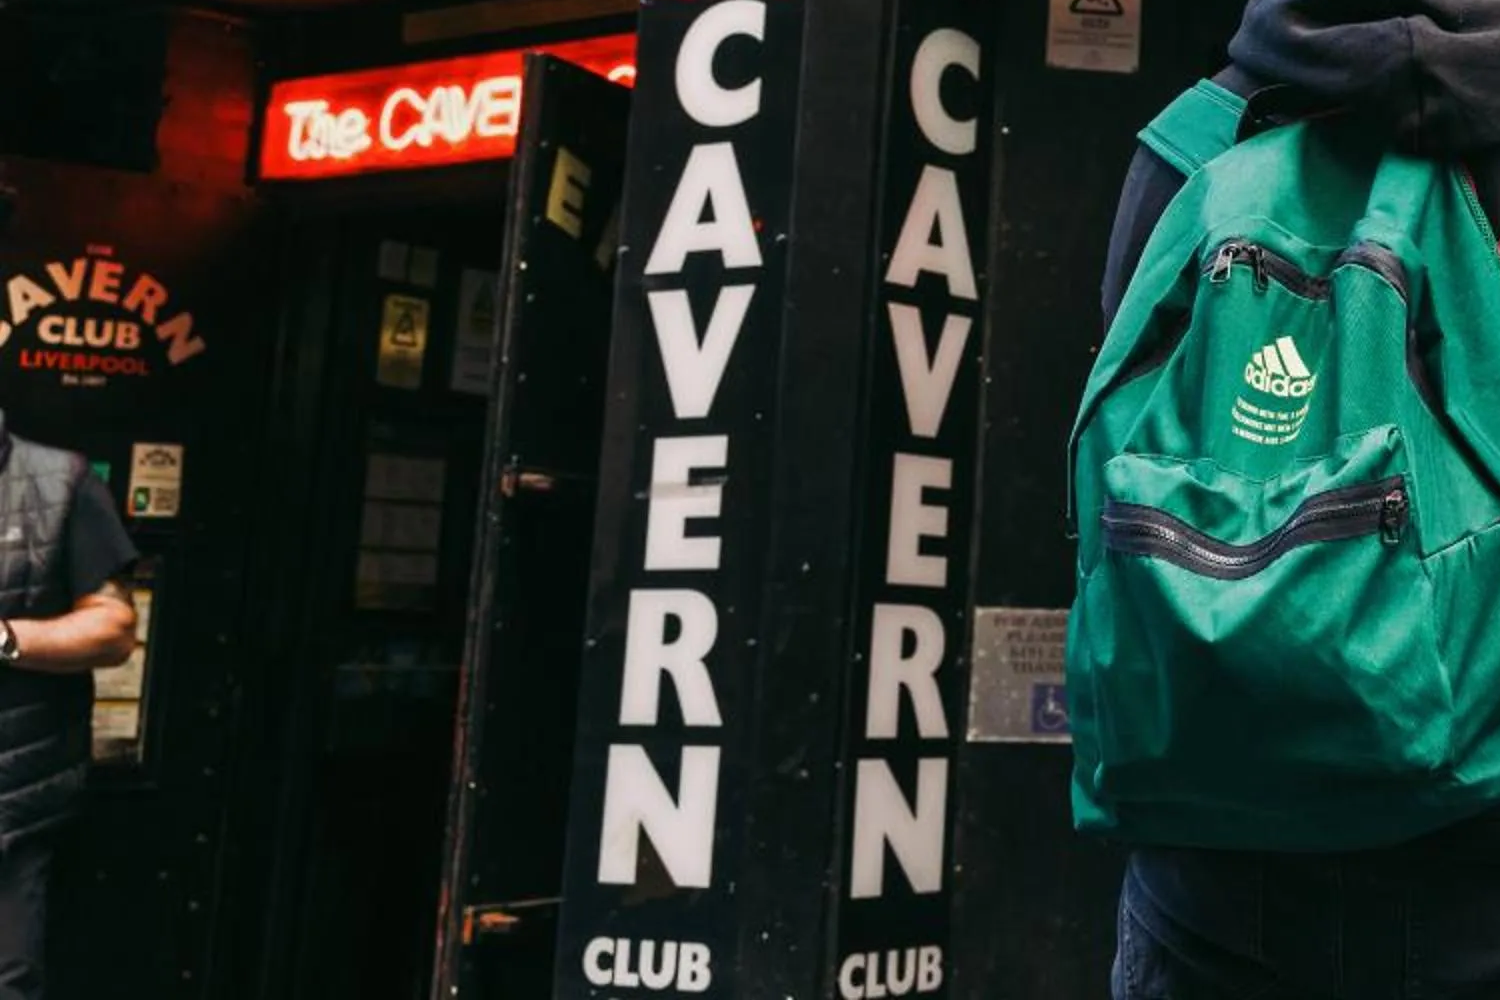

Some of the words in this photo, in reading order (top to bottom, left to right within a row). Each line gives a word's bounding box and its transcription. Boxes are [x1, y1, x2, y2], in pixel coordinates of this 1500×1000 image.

[285, 100, 372, 161] The
[380, 75, 522, 150] CAVE
[37, 313, 141, 349] CLUB
[19, 349, 150, 376] LIVERPOOL
[1244, 362, 1318, 398] adidas
[850, 28, 980, 898] CAVERN
[583, 937, 712, 992] CLUB
[838, 945, 943, 1000] CLUB
